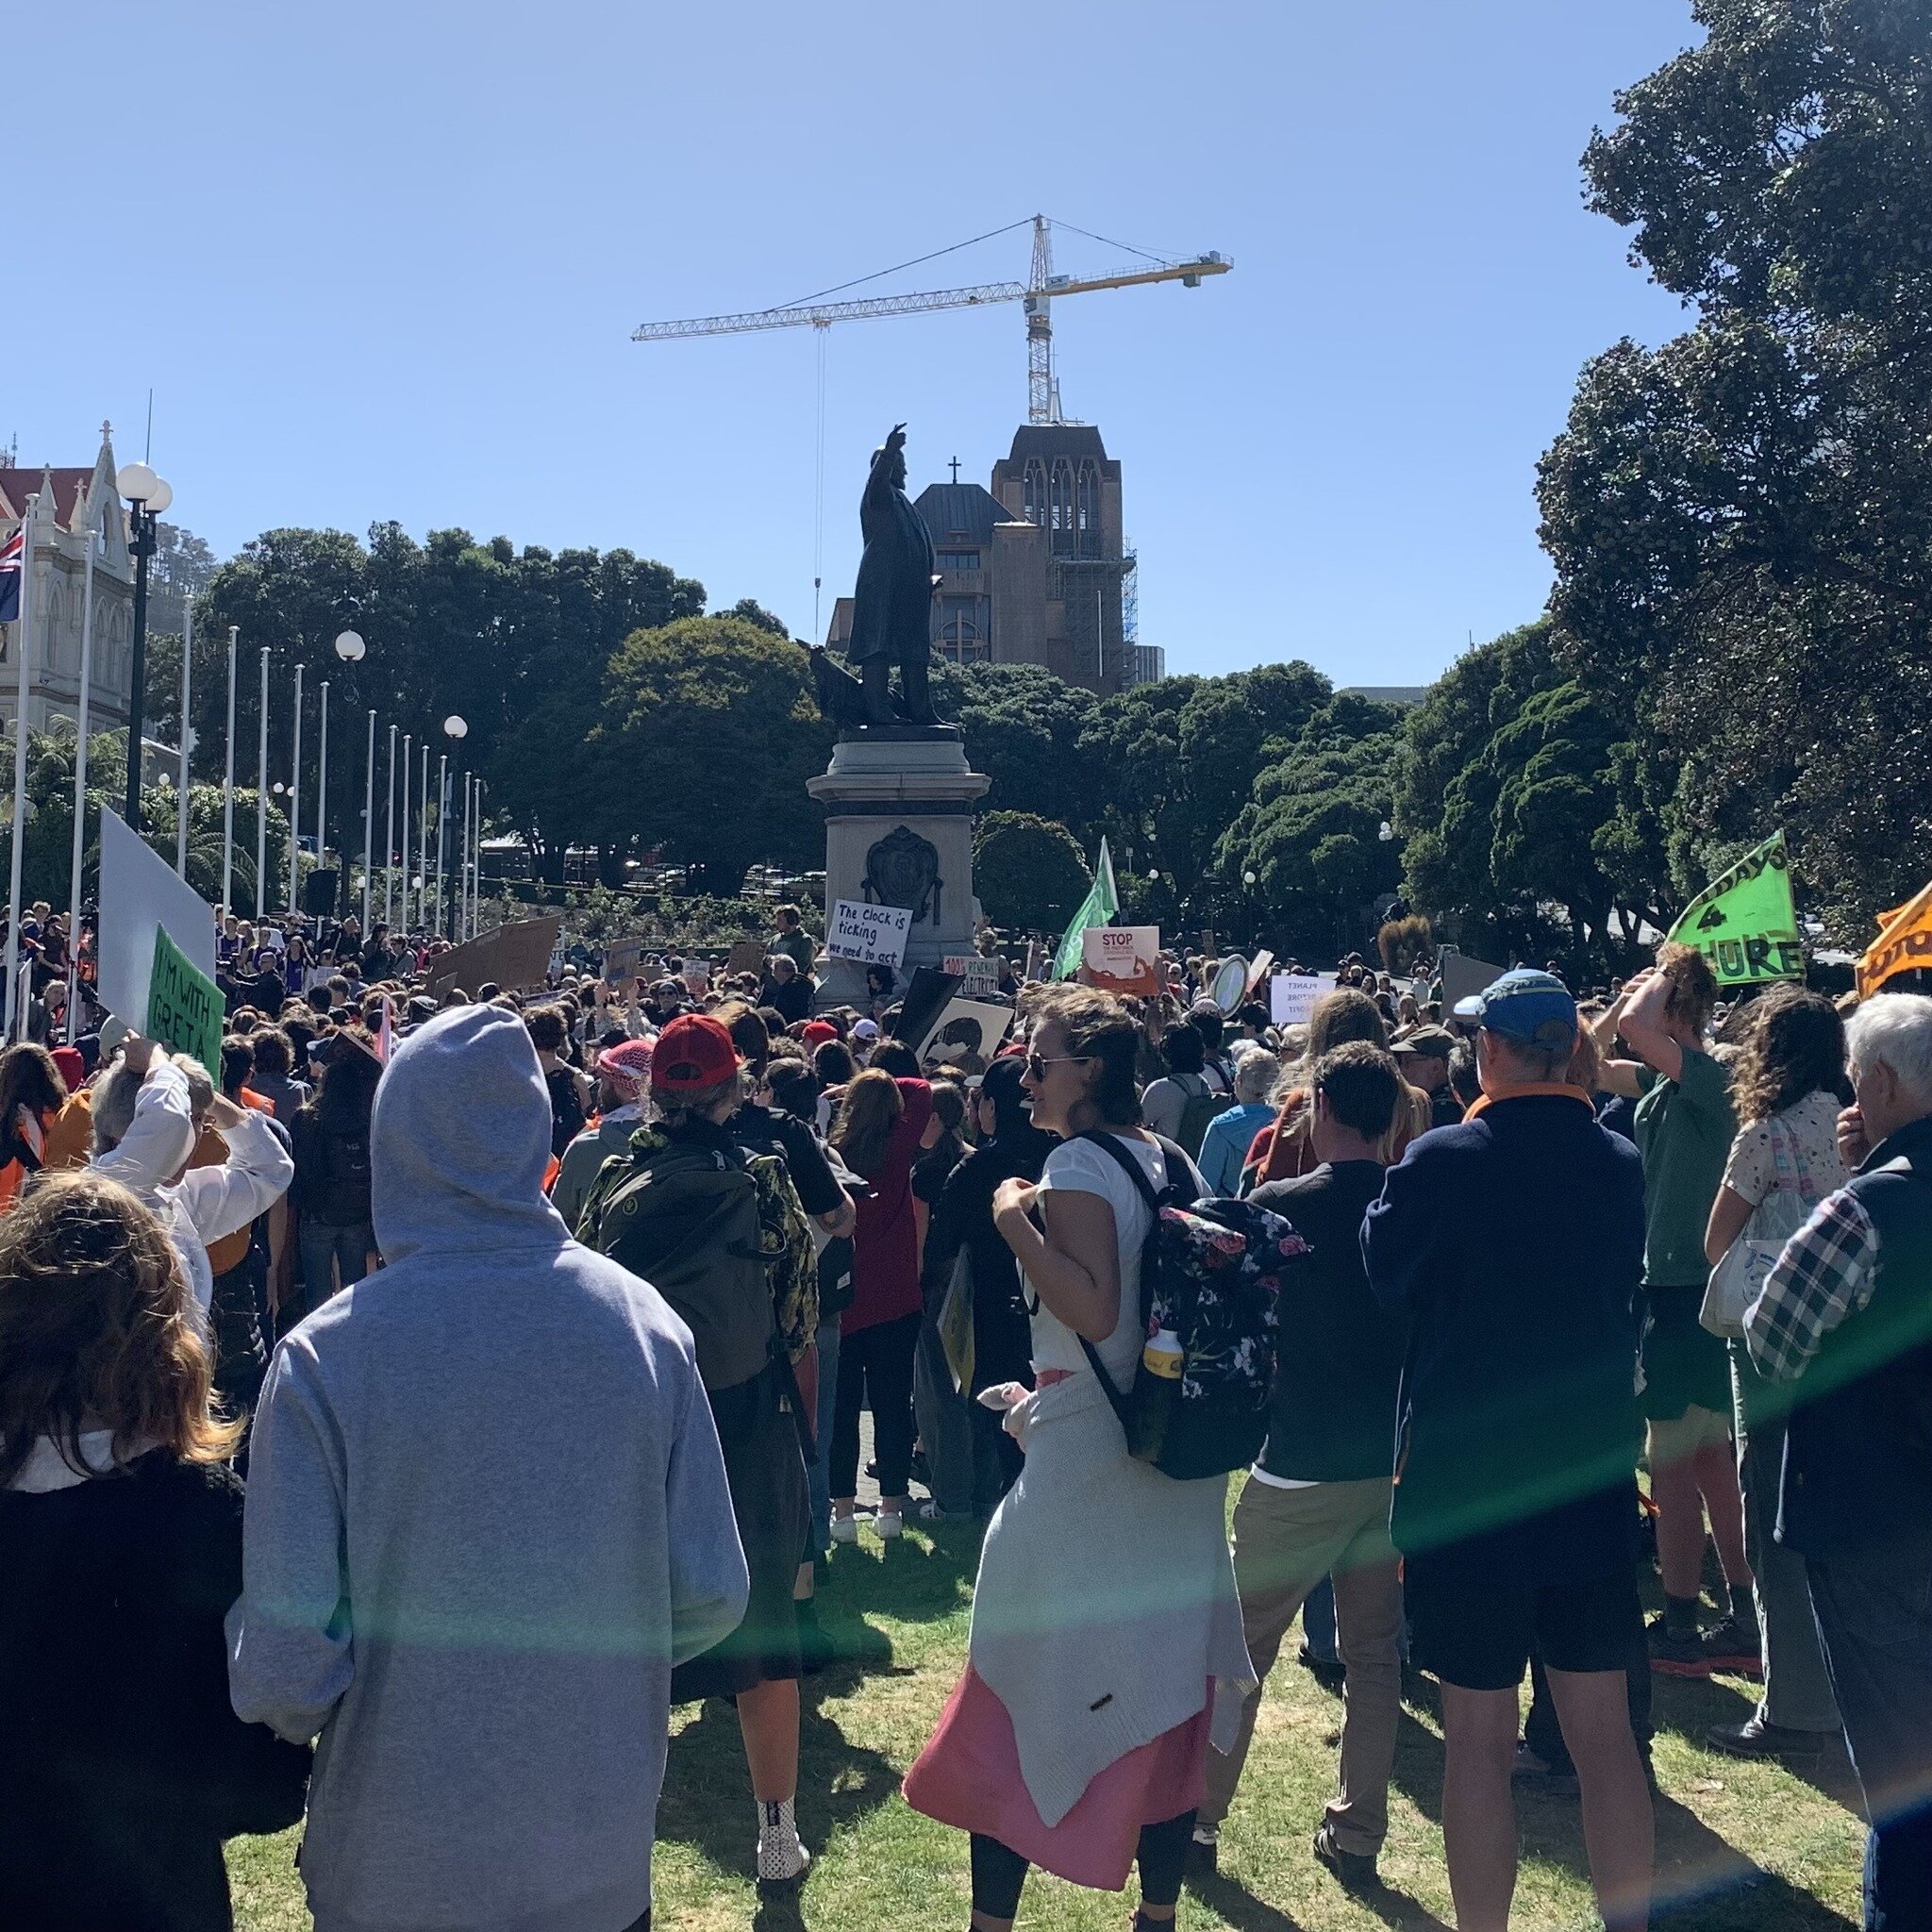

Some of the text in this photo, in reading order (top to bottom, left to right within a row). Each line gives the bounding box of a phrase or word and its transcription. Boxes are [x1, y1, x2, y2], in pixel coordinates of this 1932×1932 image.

[839, 904, 858, 919] The
[894, 911, 906, 930] is
[1696, 903, 1727, 934] 4
[839, 920, 877, 946] ticking
[1102, 933, 1133, 945] STOP
[842, 945, 862, 958] need
[865, 948, 874, 960] to
[878, 951, 897, 963] act
[156, 946, 210, 1028] I'M WITH
[152, 993, 206, 1064] GRETA
